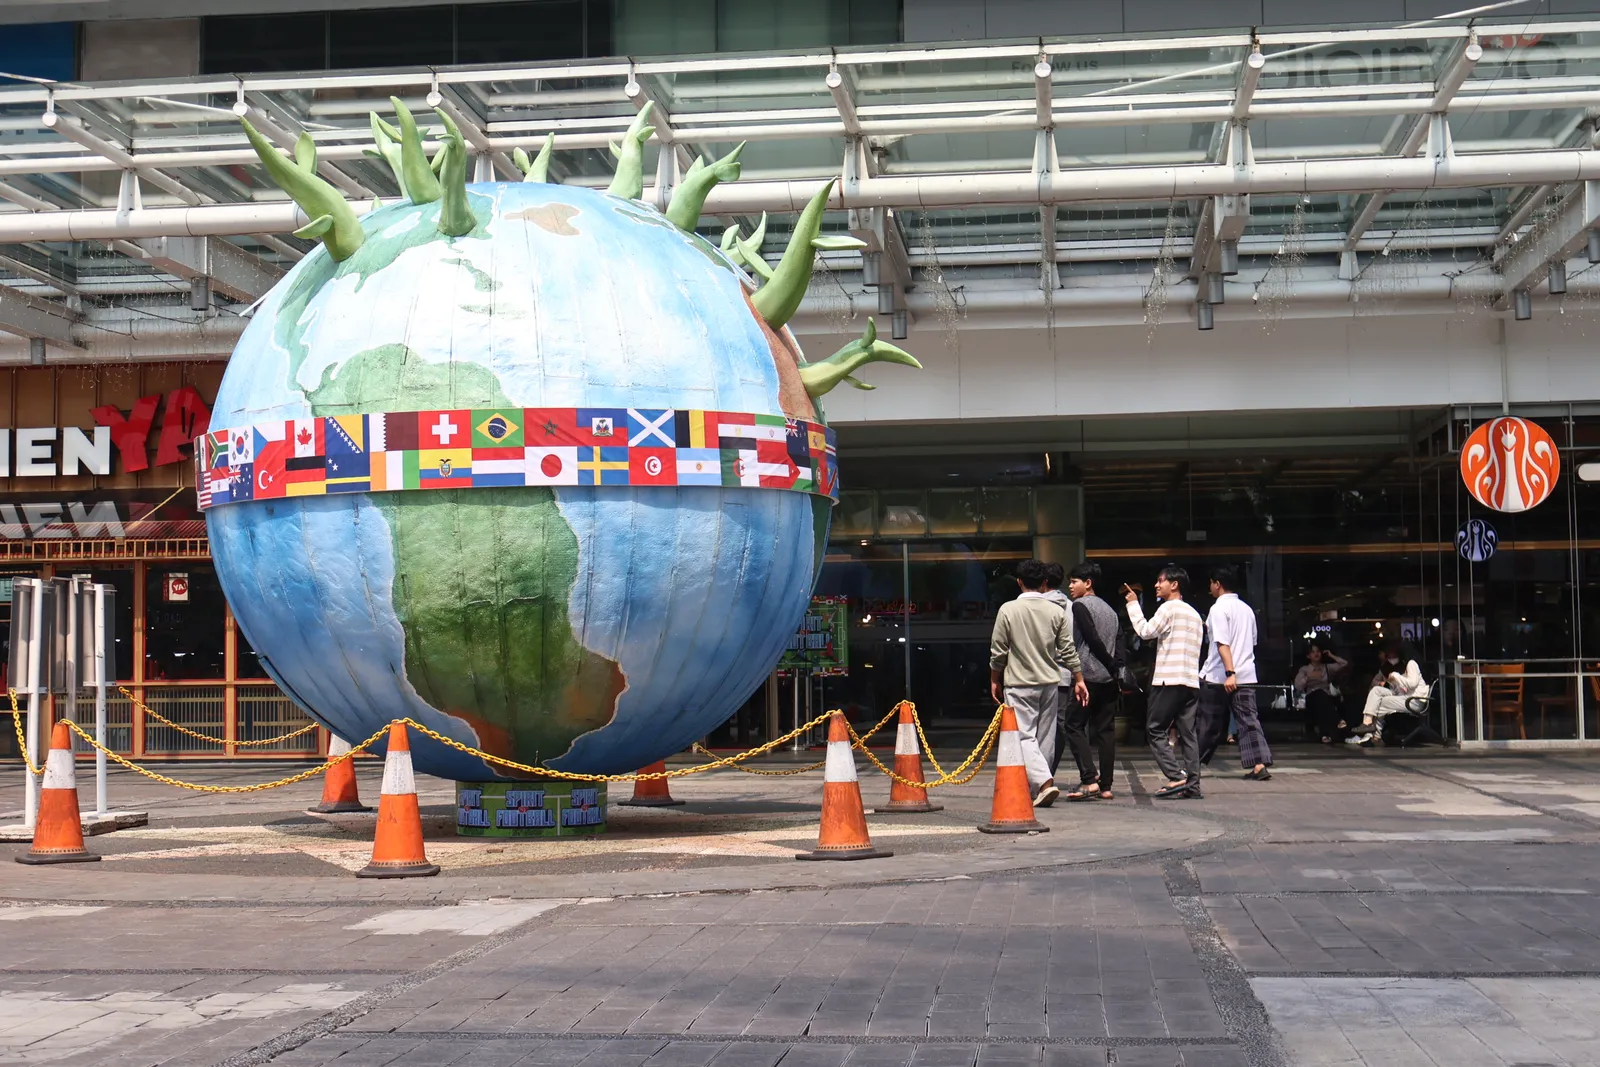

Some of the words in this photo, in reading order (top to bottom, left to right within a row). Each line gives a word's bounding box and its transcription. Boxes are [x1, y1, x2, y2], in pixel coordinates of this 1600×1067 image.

[0, 426, 111, 477] EN
[505, 790, 545, 808] SPIRIT
[496, 808, 556, 827] FOOTBALL
